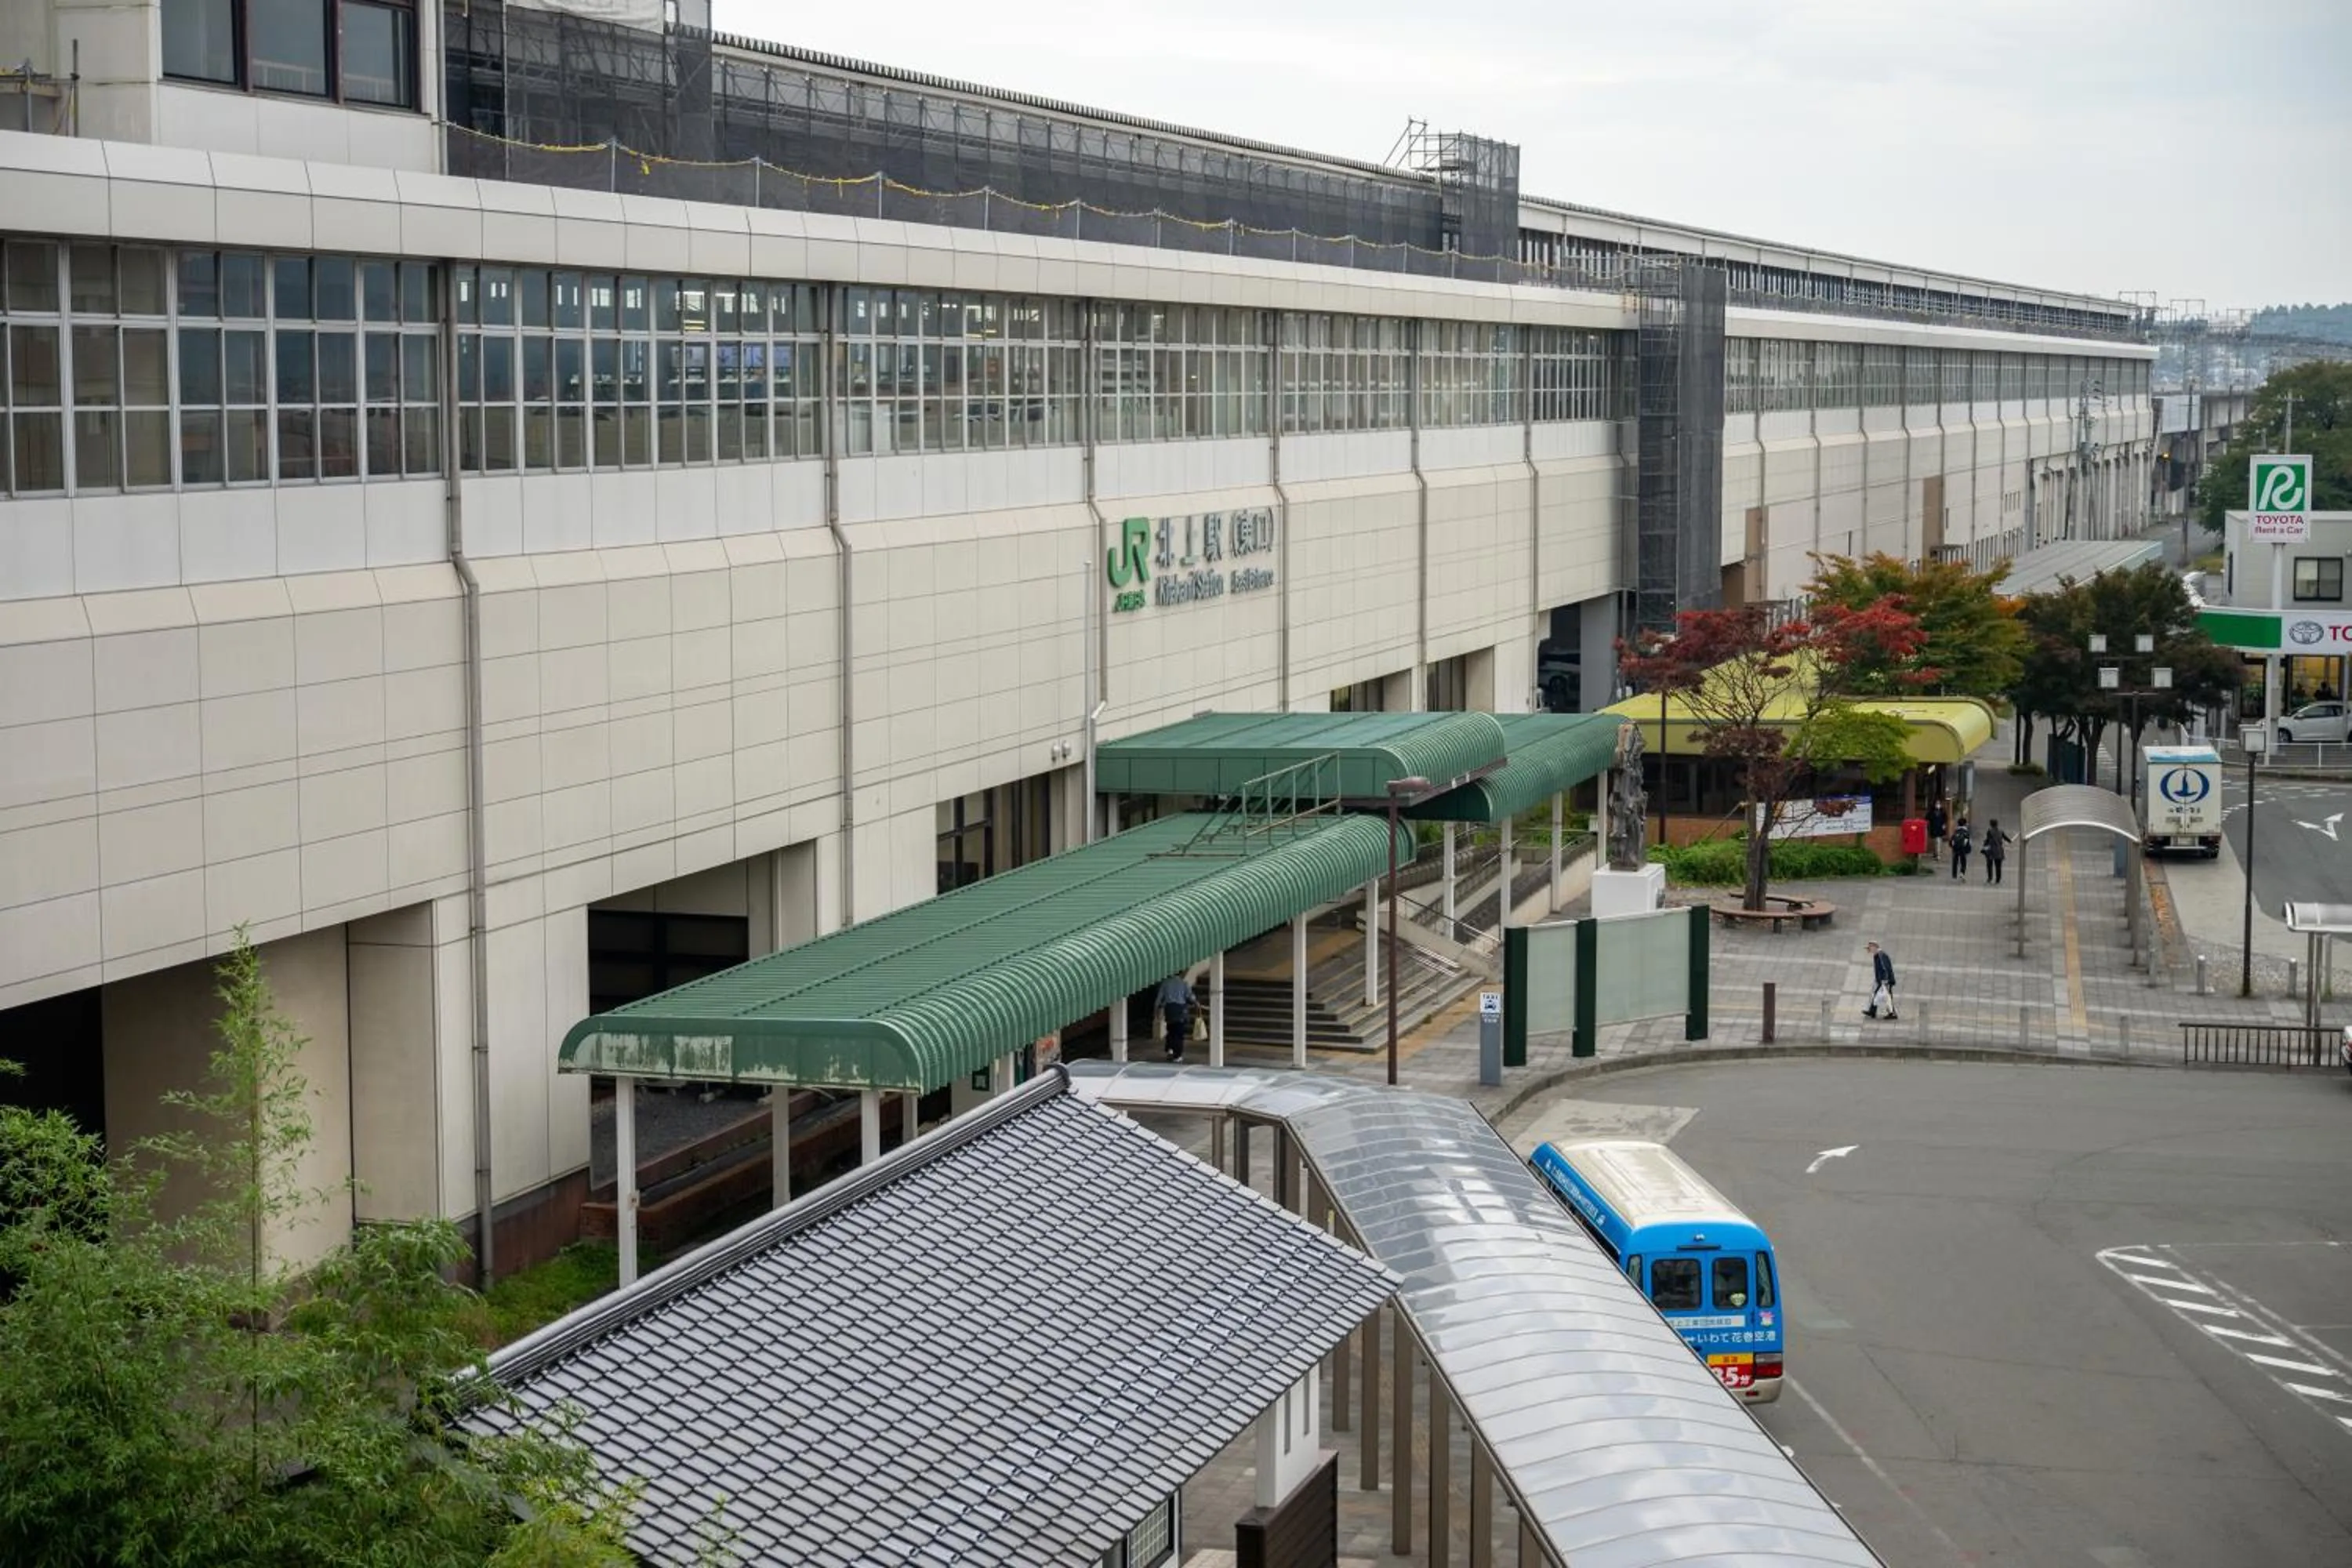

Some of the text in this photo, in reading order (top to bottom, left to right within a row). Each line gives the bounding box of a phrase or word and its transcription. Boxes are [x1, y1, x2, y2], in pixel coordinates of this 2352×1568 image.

[2256, 515, 2304, 524] TOYOTA
[1108, 517, 1150, 588] JR
[1697, 1330, 1776, 1343] いわて花巻空港
